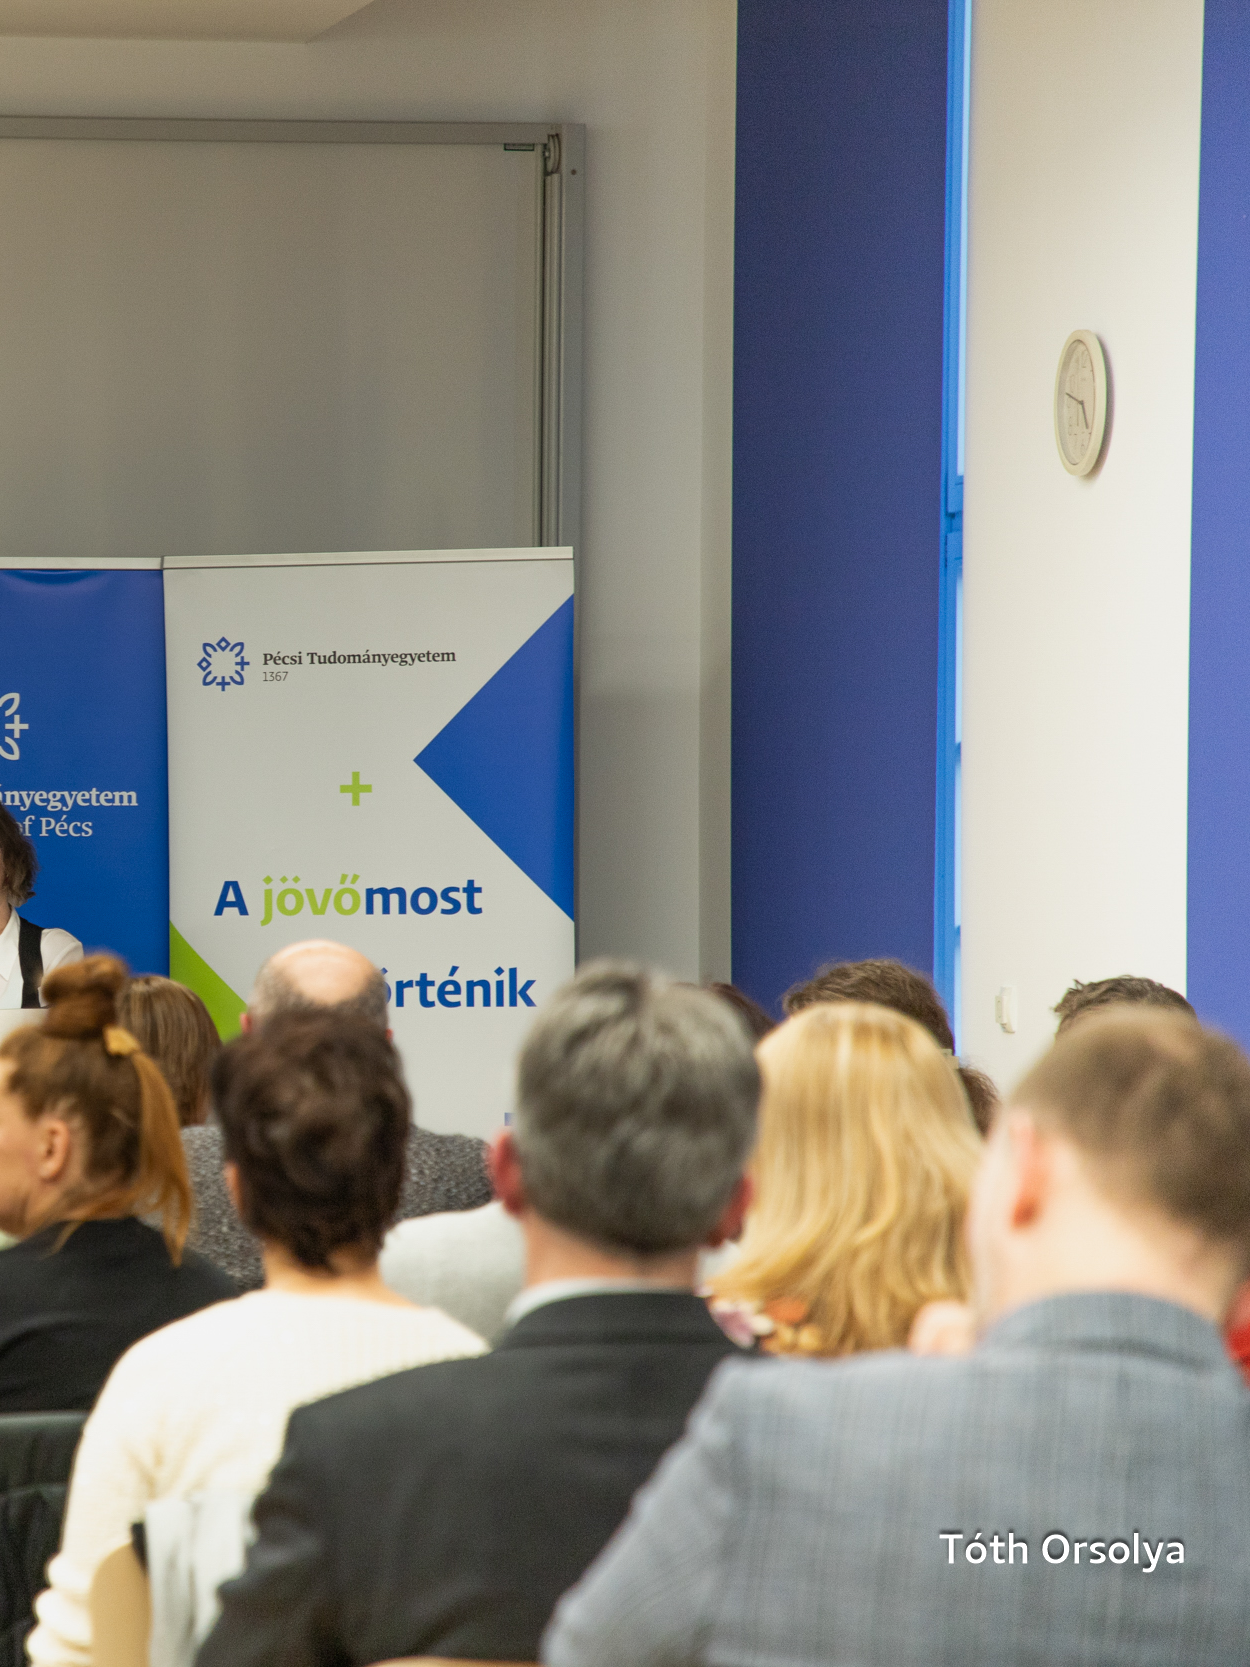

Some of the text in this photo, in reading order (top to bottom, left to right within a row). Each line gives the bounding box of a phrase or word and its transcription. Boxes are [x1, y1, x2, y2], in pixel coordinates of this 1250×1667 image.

[262, 649, 457, 667] Pécsi Tudományegyetem
[262, 670, 289, 682] 1367
[39, 816, 94, 838] Pécs
[213, 880, 249, 917] A
